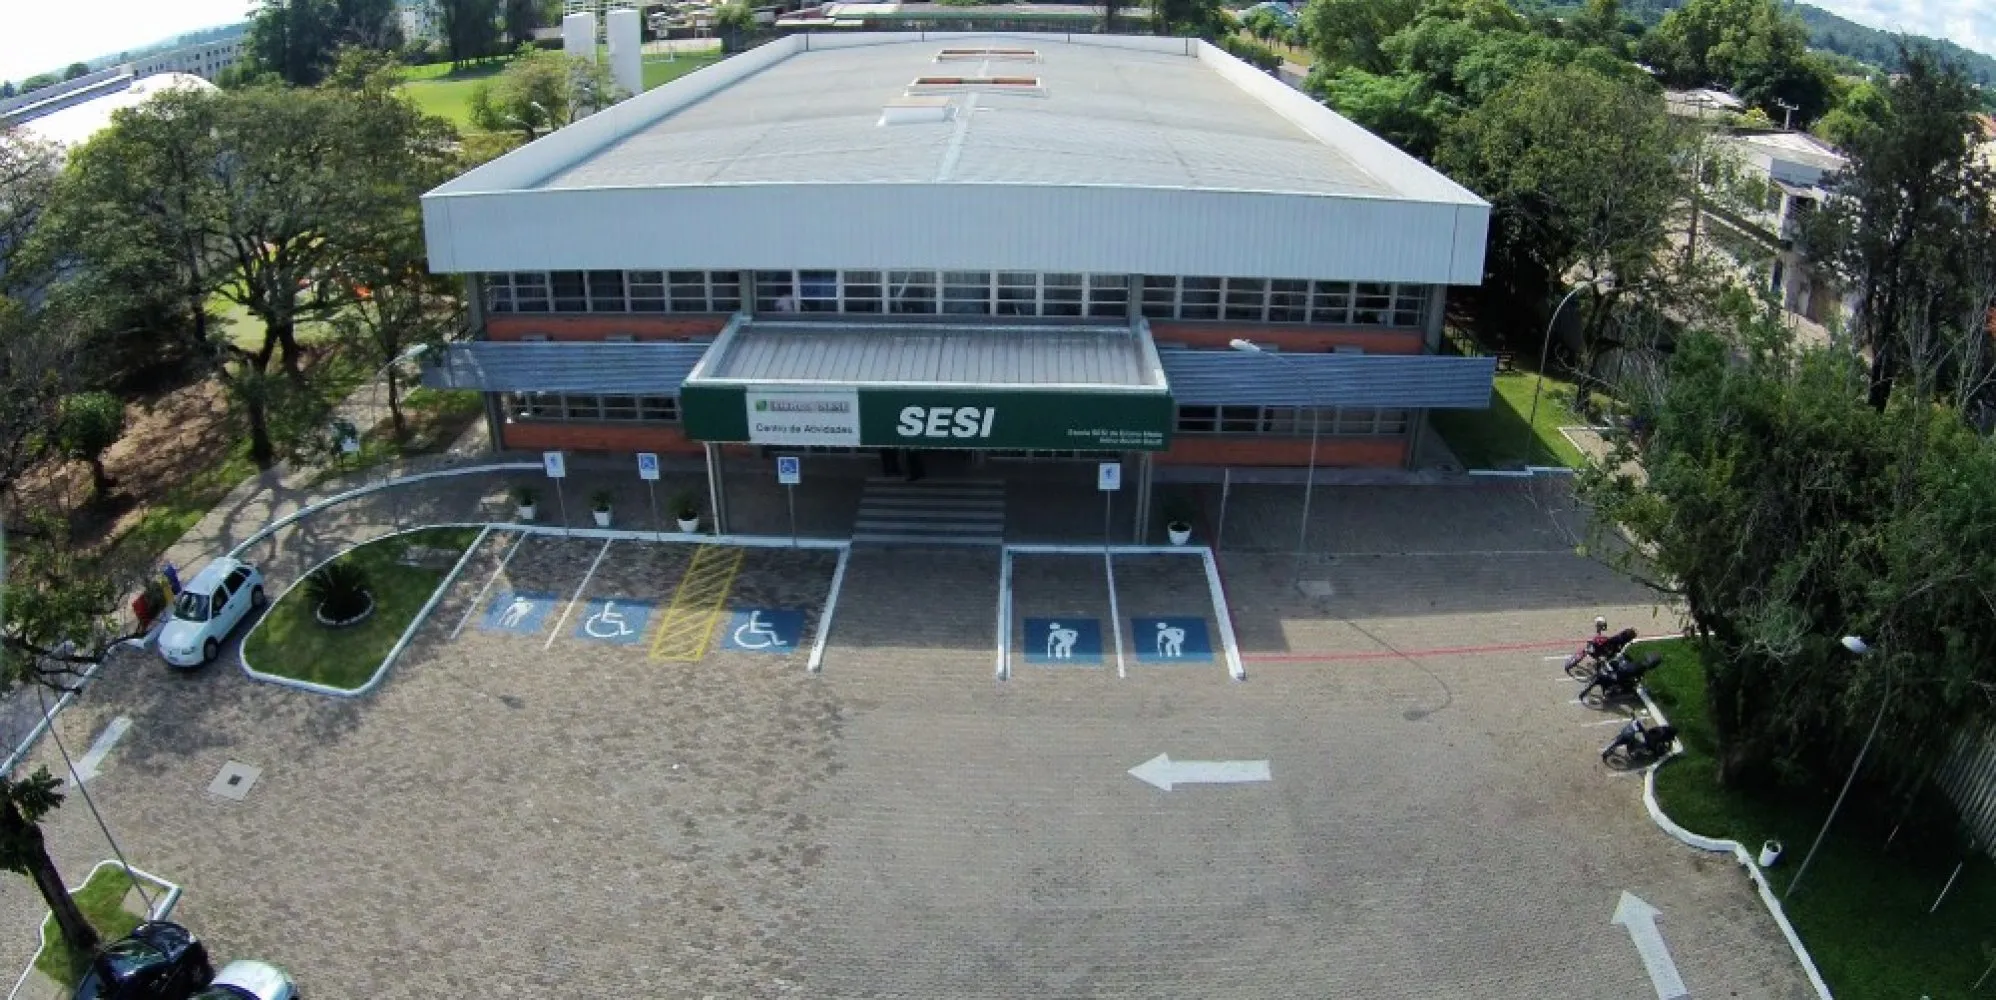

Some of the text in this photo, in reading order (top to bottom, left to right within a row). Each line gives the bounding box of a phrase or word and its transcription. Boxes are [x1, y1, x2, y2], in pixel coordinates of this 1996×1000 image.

[756, 423, 853, 434] Centro de Atividades
[897, 406, 995, 438] SESI
